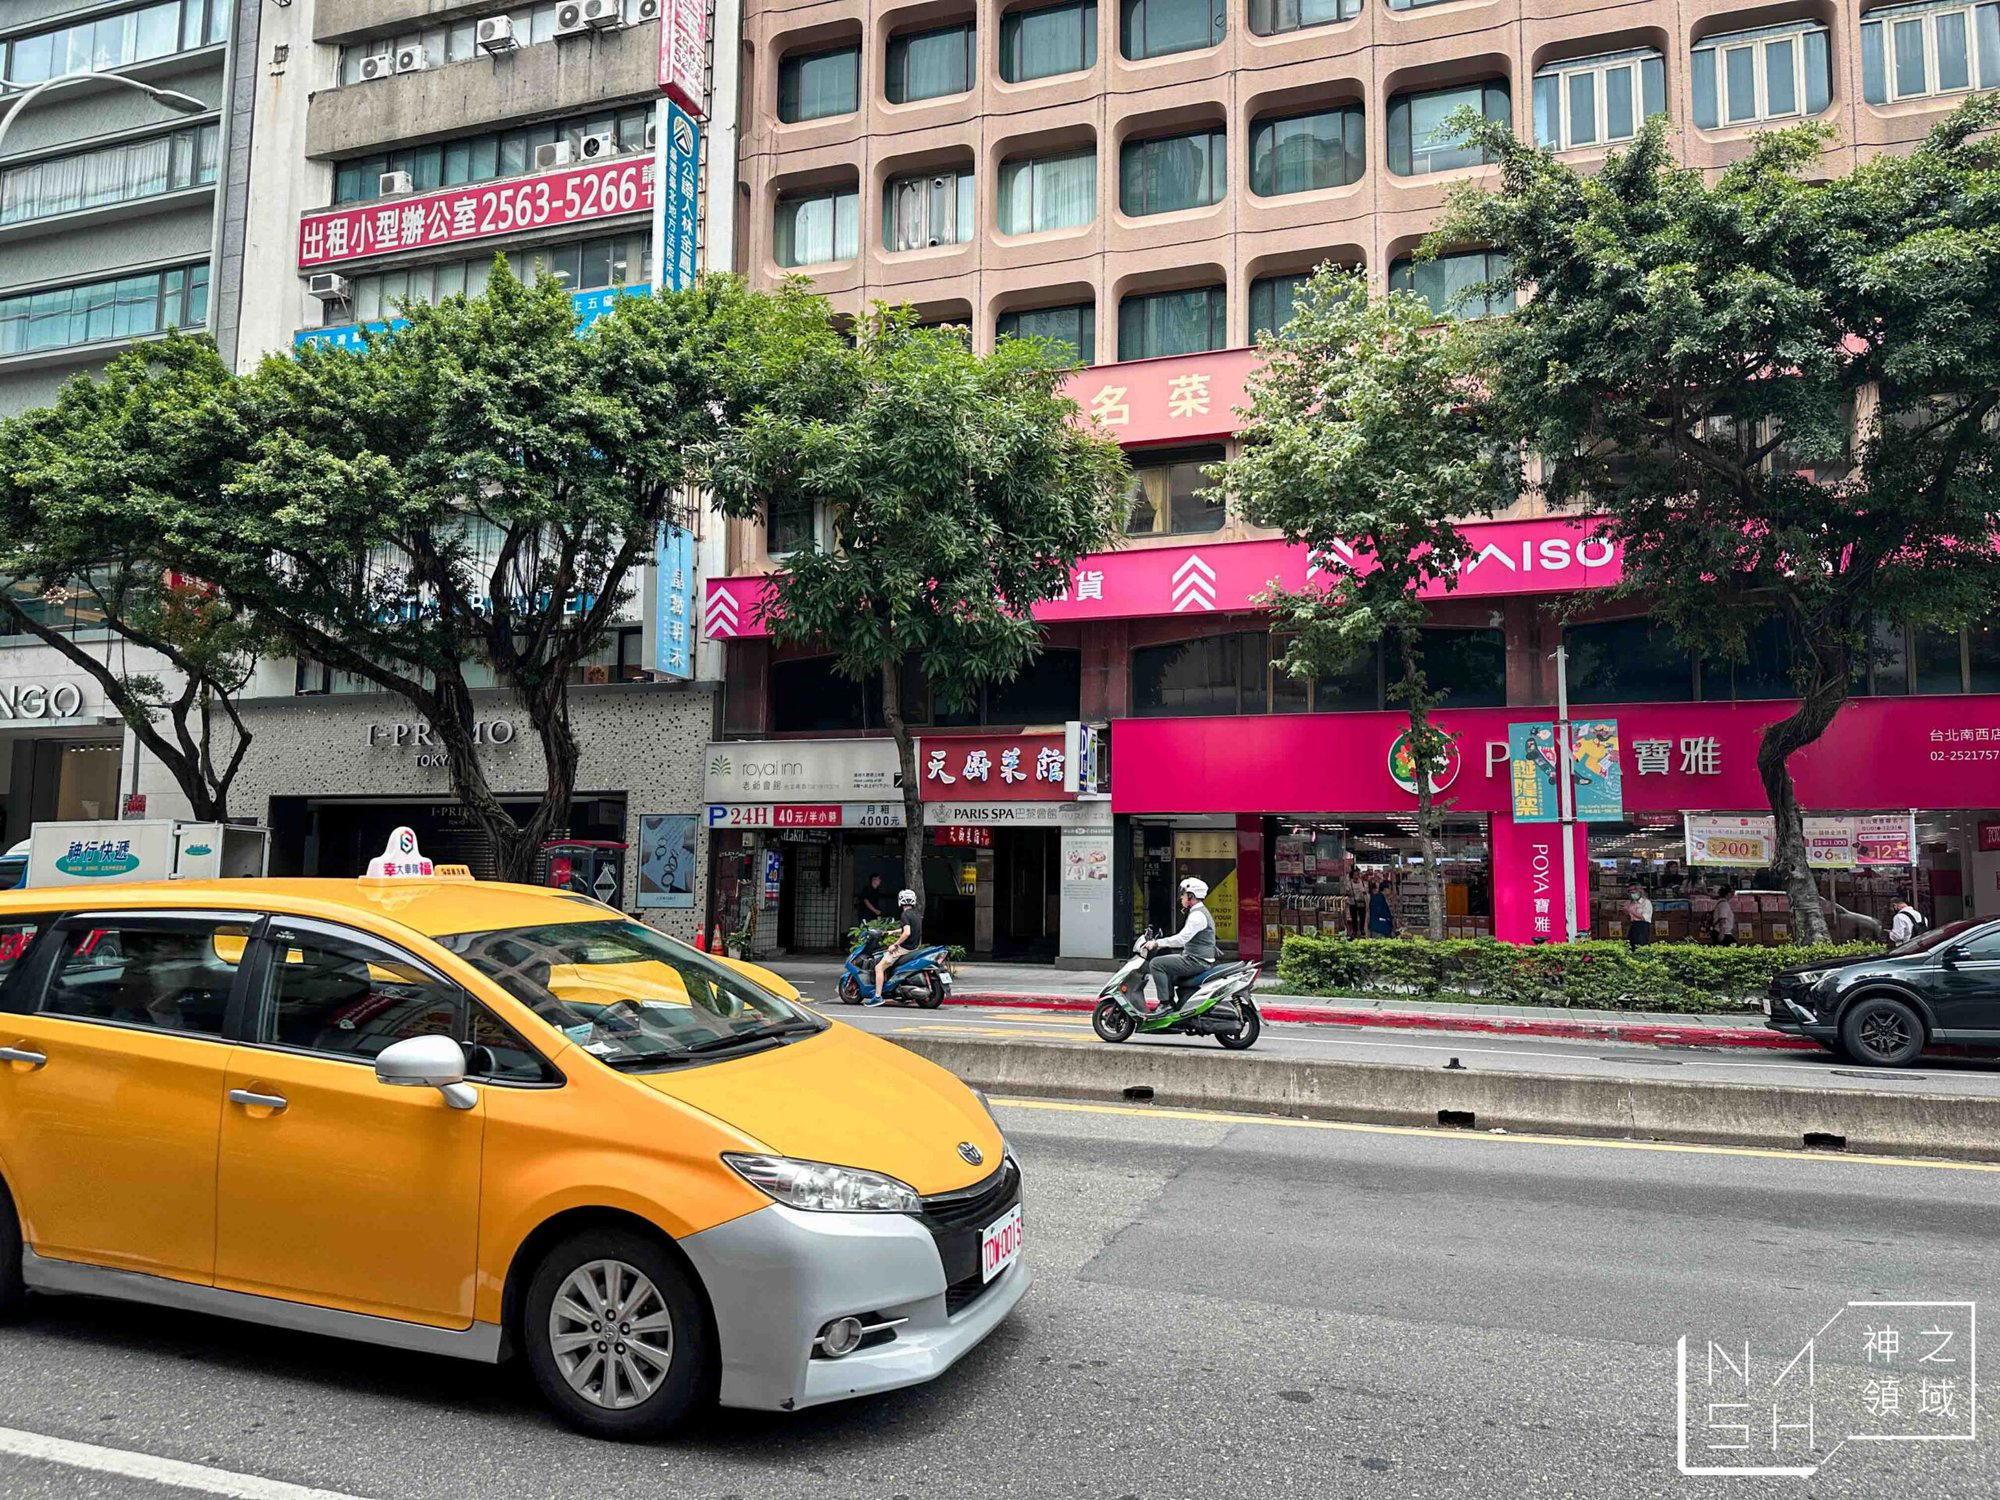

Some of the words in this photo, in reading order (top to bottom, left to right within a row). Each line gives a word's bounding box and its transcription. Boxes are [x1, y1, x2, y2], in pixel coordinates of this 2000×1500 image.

[927, 746, 1065, 784] 天廚菜館
[1632, 736, 1723, 775] 寶雅
[742, 760, 778, 778] royal
[781, 762, 803, 776] inn
[709, 806, 728, 827] P
[730, 807, 769, 825] 24H
[859, 816, 901, 827] 4000元
[954, 808, 989, 819] PARIS
[991, 808, 1015, 819] SPA
[1532, 844, 1550, 894] POYA
